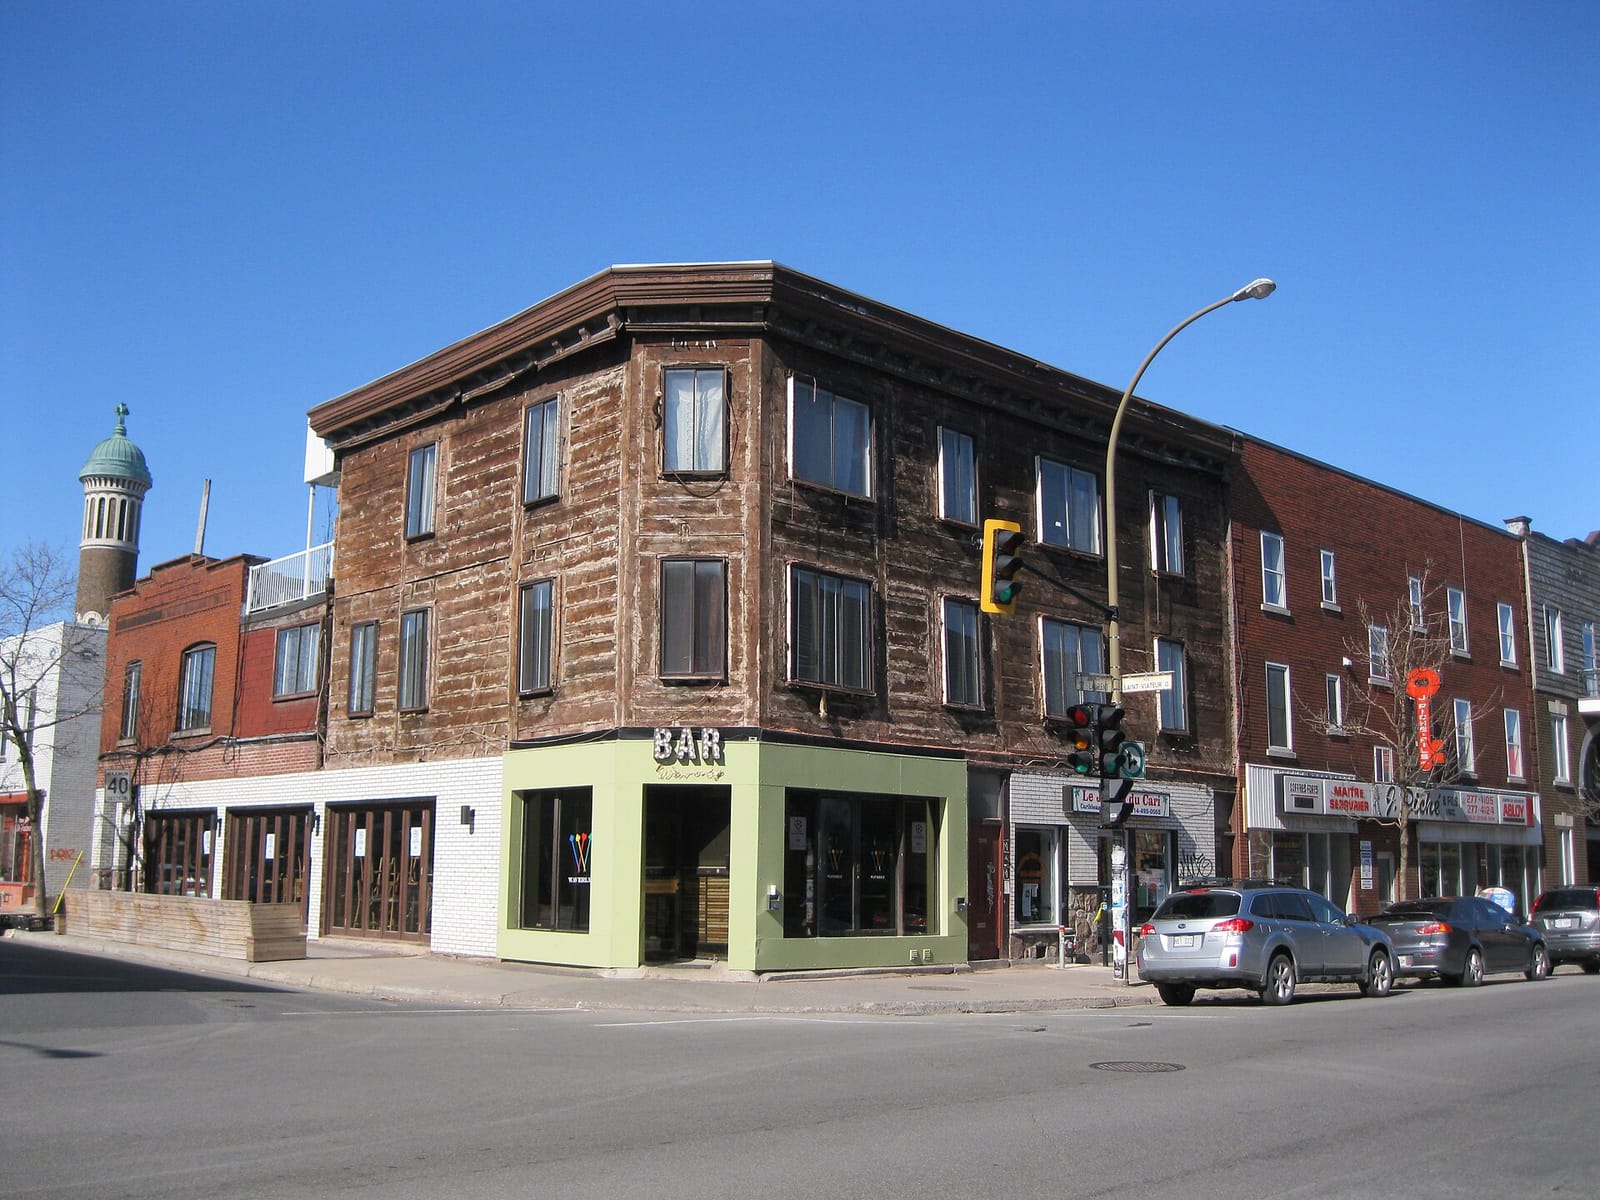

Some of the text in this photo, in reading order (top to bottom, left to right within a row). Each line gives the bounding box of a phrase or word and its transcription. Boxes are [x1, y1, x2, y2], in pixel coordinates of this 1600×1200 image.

[653, 727, 721, 760] BAR
[107, 777, 128, 794] 40
[1082, 789, 1094, 802] Le
[1129, 793, 1140, 804] du
[1143, 794, 1160, 807] Cari
[1503, 803, 1525, 817] ABLOY
